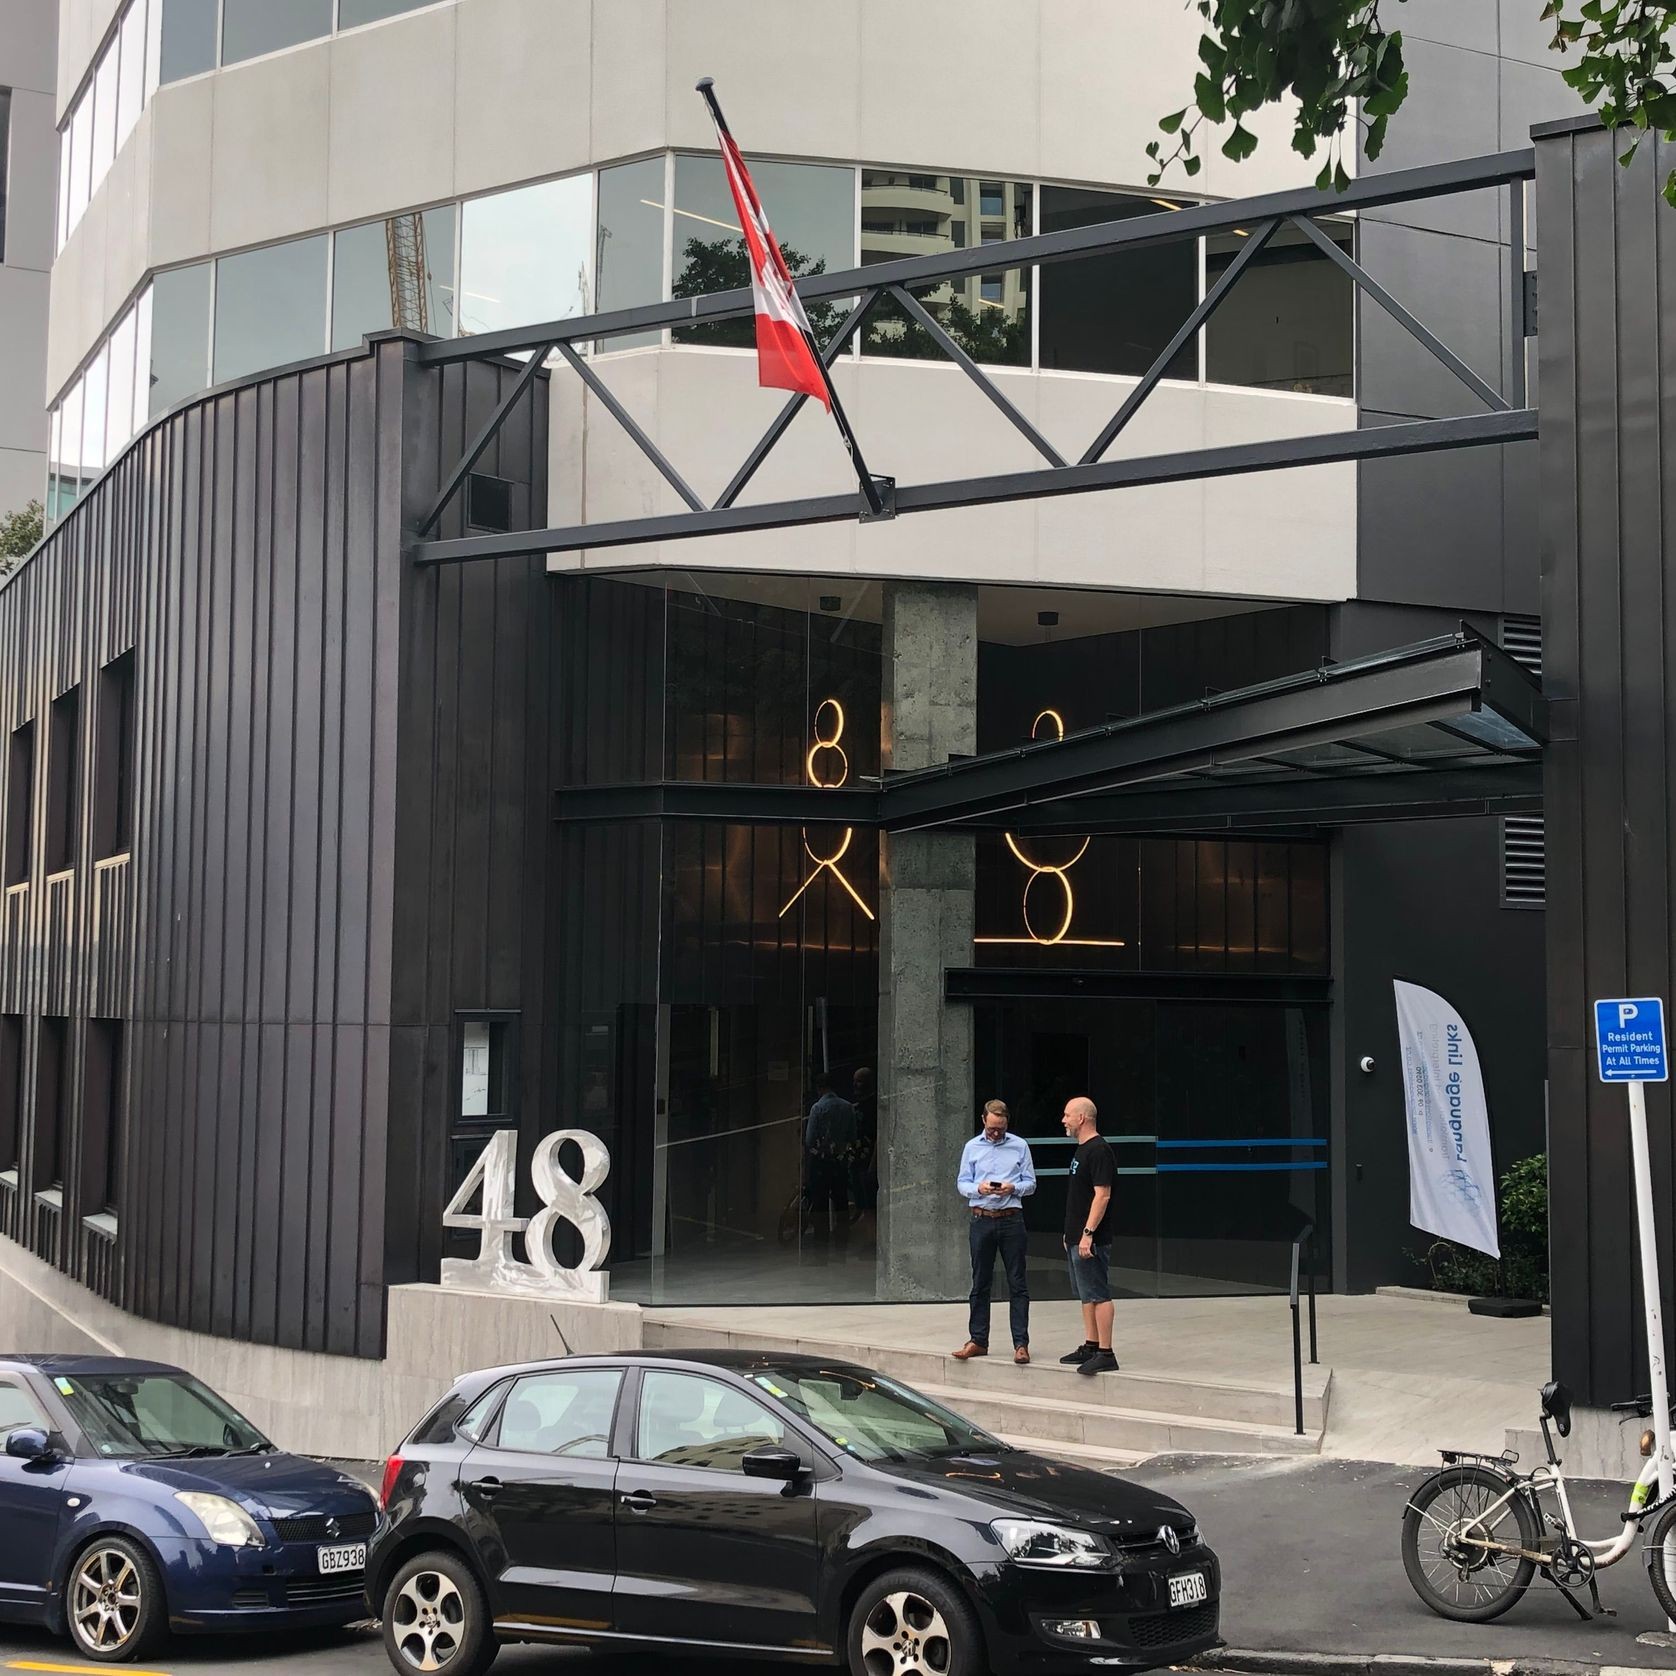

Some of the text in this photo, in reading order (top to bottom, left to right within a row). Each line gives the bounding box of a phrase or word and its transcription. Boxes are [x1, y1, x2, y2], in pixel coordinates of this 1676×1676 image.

[1618, 1003, 1638, 1028] P
[1607, 1031, 1653, 1041] Resident
[1602, 1043, 1661, 1053] Permit Parking
[1606, 1056, 1660, 1066] At All Times
[442, 1129, 612, 1285] 48
[321, 1548, 365, 1570] GBZ938
[1169, 1575, 1206, 1603] GFH318
